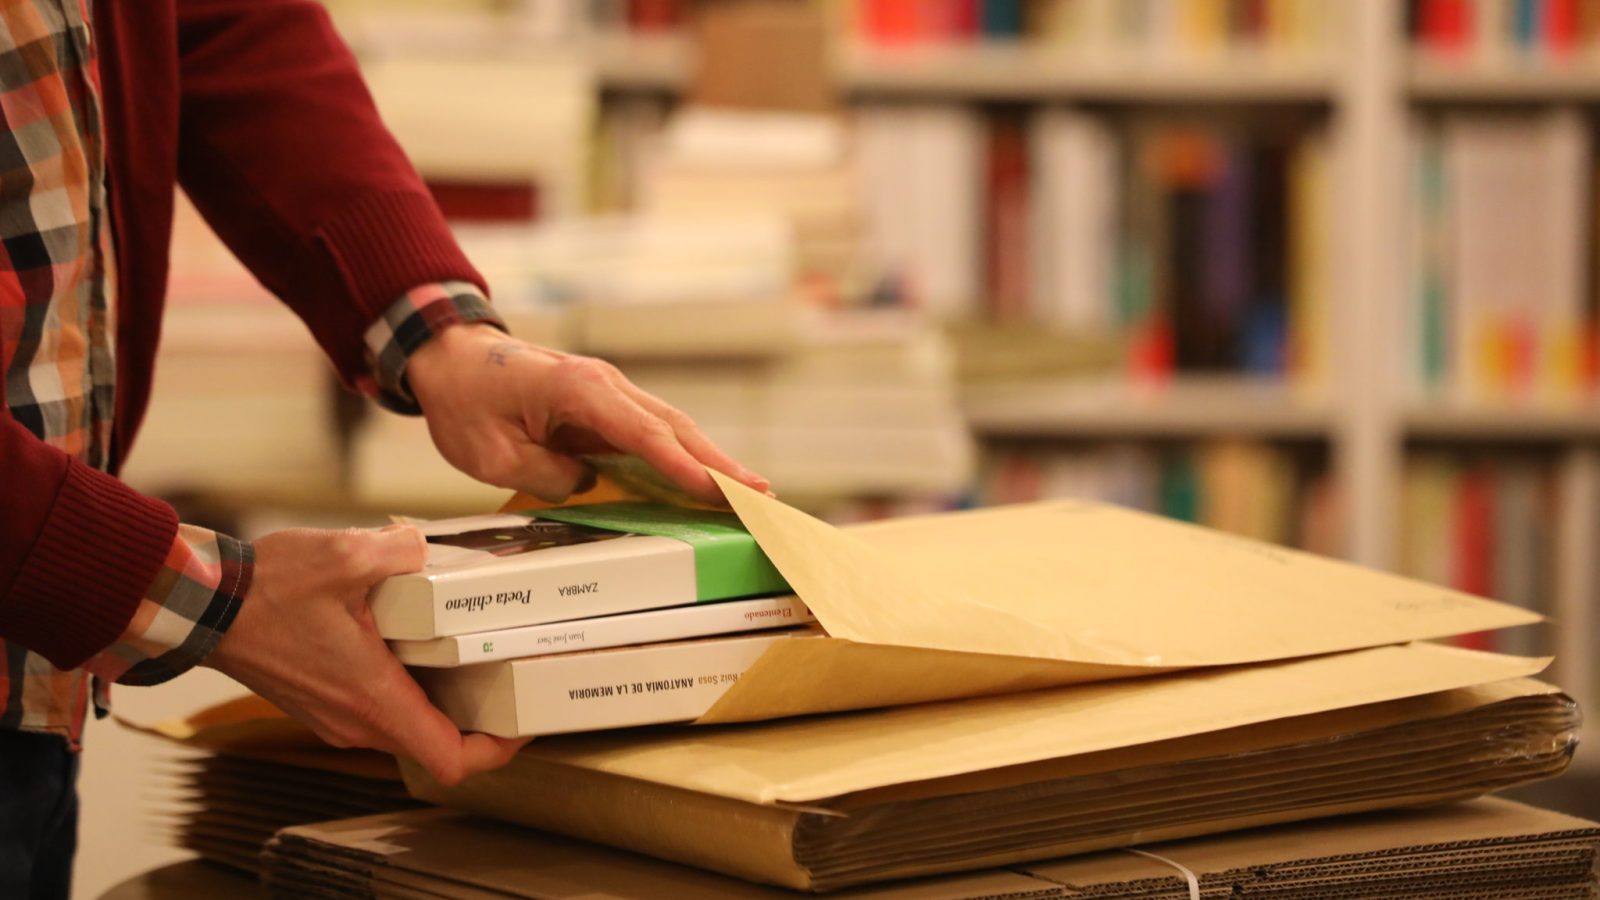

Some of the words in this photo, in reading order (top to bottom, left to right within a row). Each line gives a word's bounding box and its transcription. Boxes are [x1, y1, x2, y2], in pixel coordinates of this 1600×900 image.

[558, 582, 599, 597] ZAMBRA
[445, 595, 493, 612] chileno
[496, 589, 532, 606] Poeta
[744, 608, 782, 621] entenado
[781, 607, 792, 618] El
[568, 631, 585, 642] Juan
[698, 675, 718, 685] Sosa
[720, 673, 739, 683] Ruiz
[616, 684, 629, 695] LA
[632, 682, 643, 694] DE
[646, 677, 694, 694] ANATOMÍA
[568, 685, 614, 701] MEMORIA
